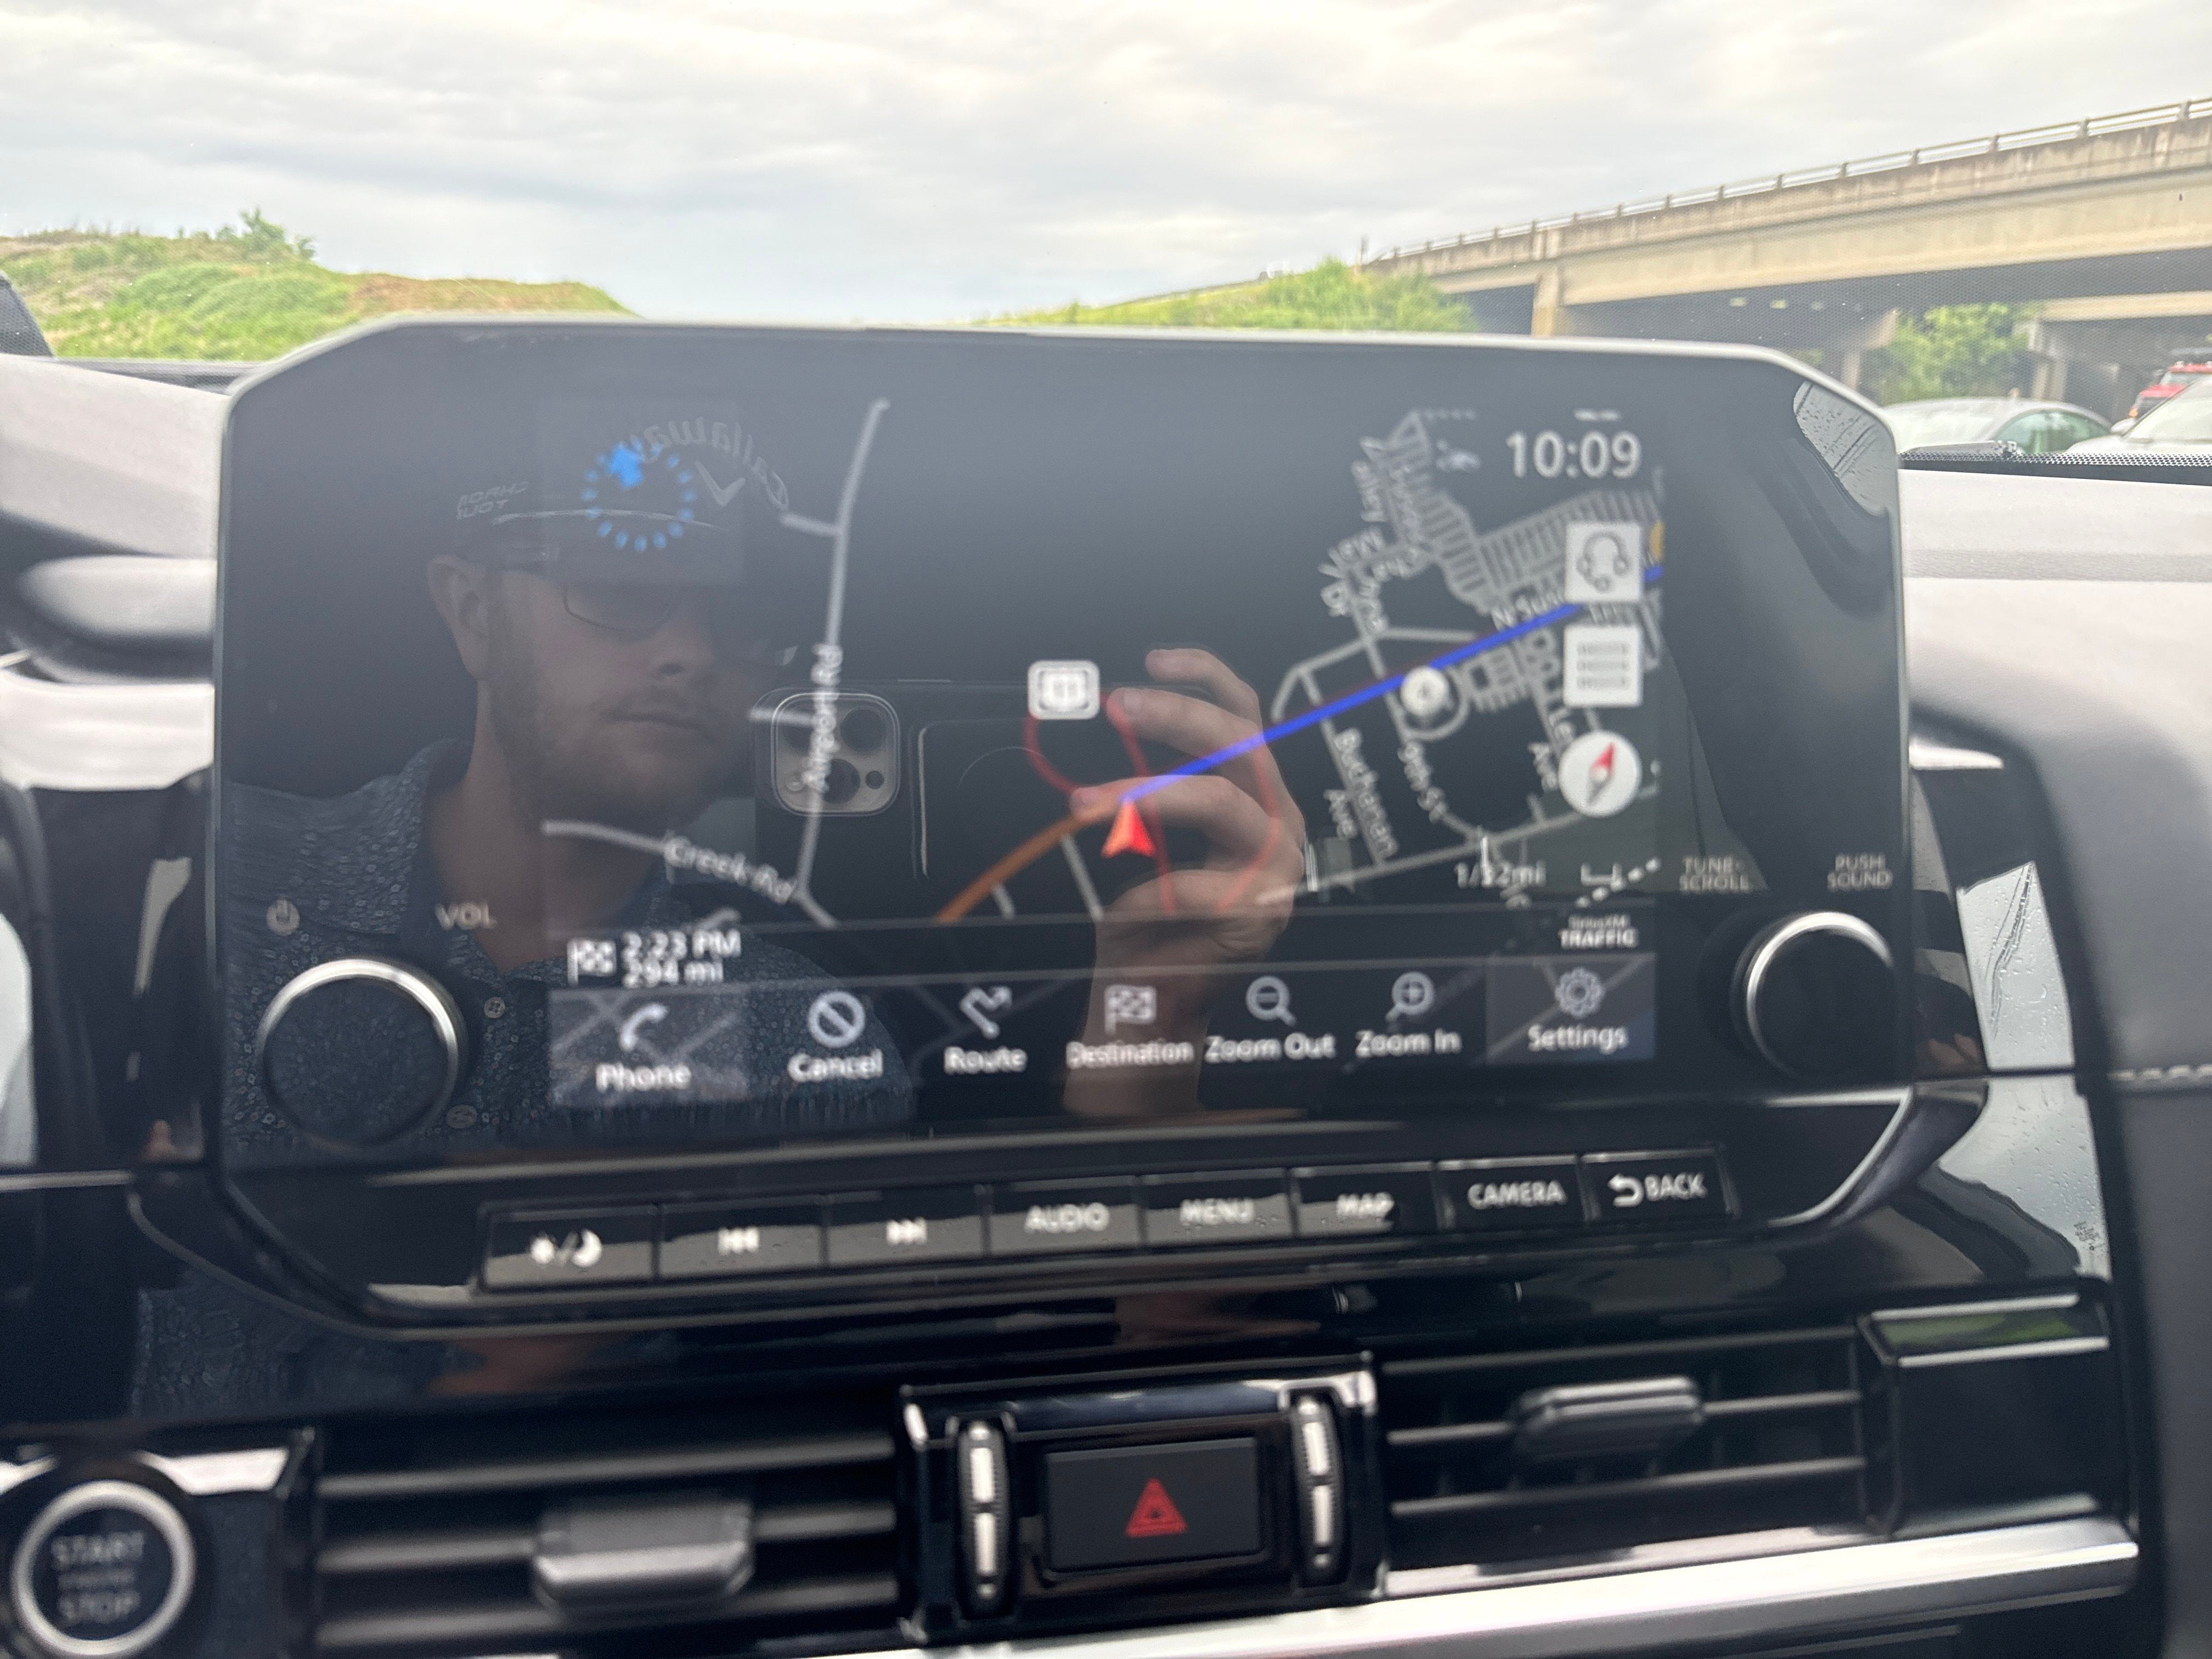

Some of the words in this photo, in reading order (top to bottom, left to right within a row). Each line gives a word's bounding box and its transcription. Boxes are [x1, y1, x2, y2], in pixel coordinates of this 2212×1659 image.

[1505, 430, 1641, 477] 10:09
[664, 836, 747, 883] Creek
[752, 864, 796, 904] Rd
[1835, 854, 1886, 871] PUSH
[1827, 871, 1893, 891] SOUND
[435, 901, 497, 930] VOL
[692, 929, 741, 958] PM
[1559, 928, 1639, 949] TRAFFIC
[1065, 1040, 1195, 1070] Destination
[1204, 1035, 1281, 1065] Zoom
[1283, 1032, 1336, 1060] Out
[1355, 1030, 1432, 1059] Zoom
[1433, 1029, 1462, 1056] In
[1528, 1024, 1629, 1056] Settings
[788, 1048, 883, 1082] Cancel
[944, 1045, 1028, 1075] Route
[596, 1062, 691, 1093] Phone
[1467, 1180, 1567, 1210] CAMERA
[1645, 1172, 1707, 1201] BACK
[1024, 1202, 1110, 1233] AUDIO
[1180, 1198, 1256, 1226] MENU
[1336, 1193, 1395, 1221] MAP
